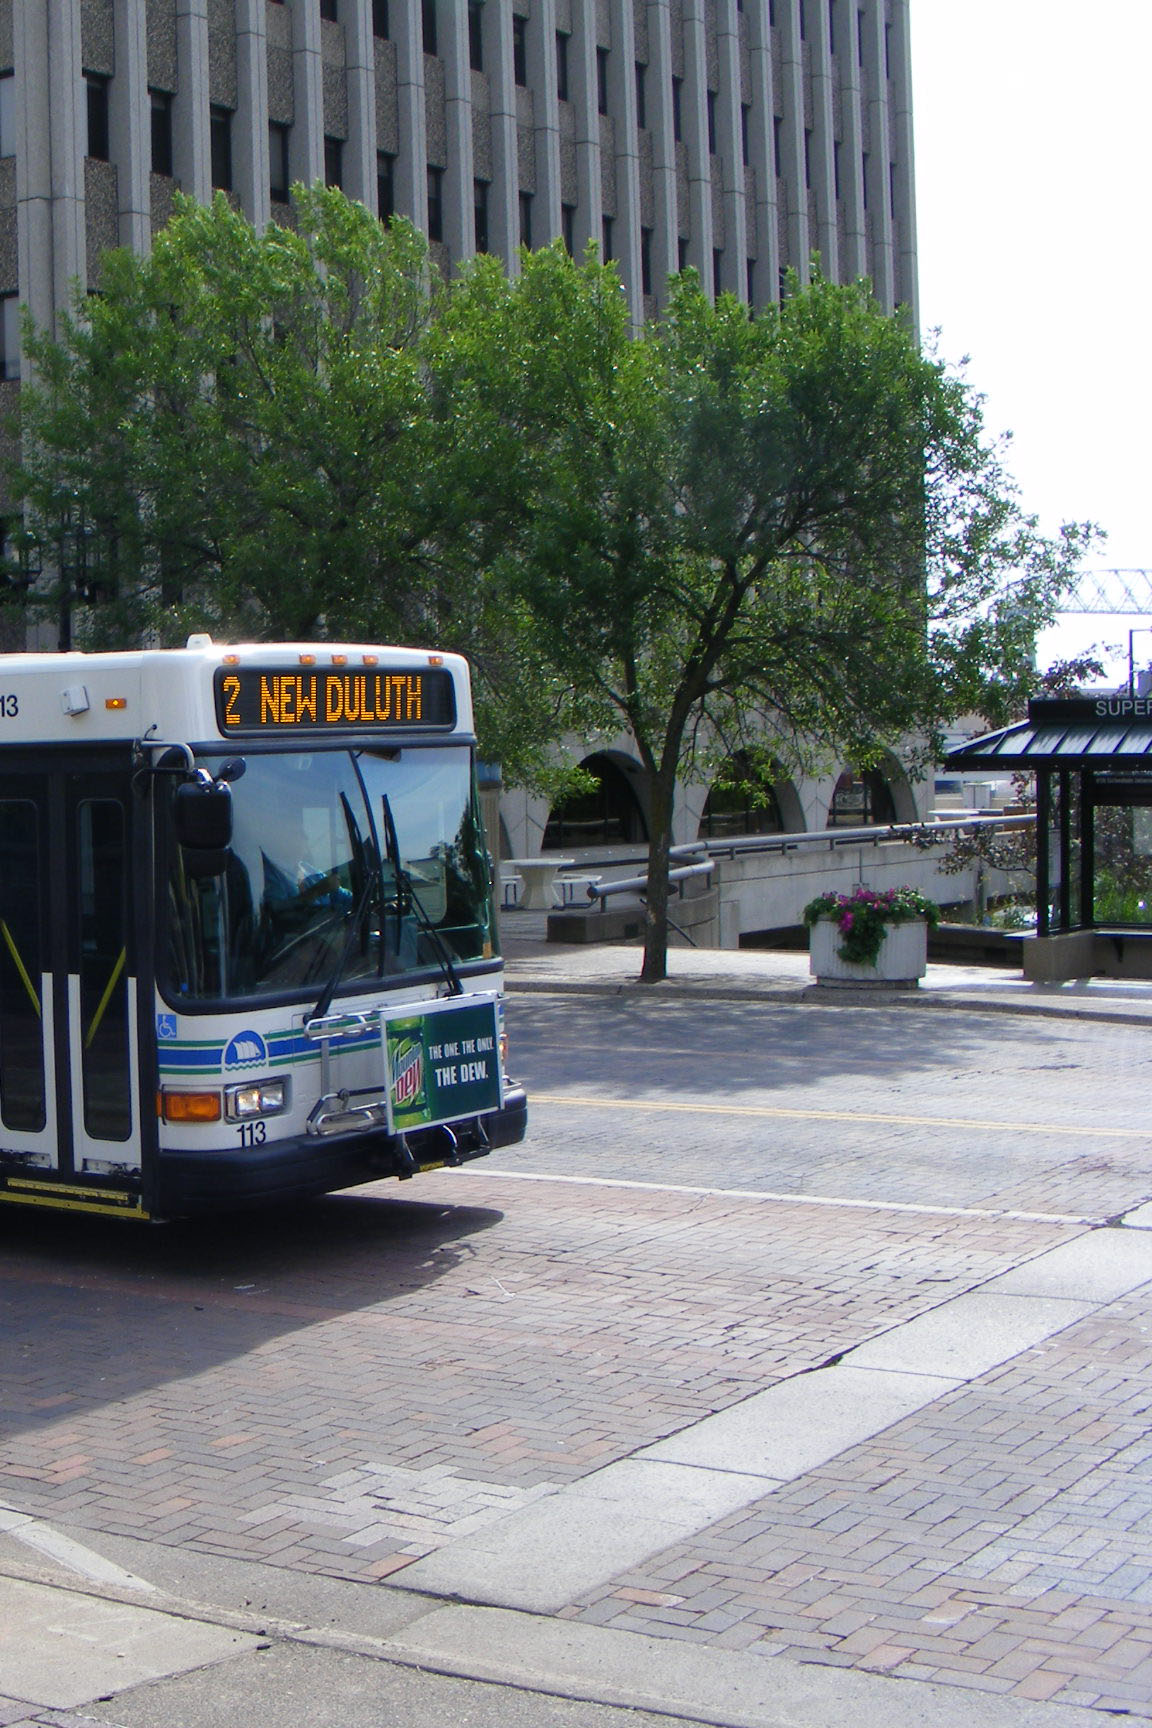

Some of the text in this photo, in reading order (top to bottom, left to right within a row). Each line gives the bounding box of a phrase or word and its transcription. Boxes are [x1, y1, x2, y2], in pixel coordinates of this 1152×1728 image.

[223, 676, 422, 724] 2 NEW DULUTH
[428, 1045, 443, 1060] THE
[462, 1039, 475, 1054] THE
[435, 1060, 488, 1087] THE DEW.
[237, 1121, 266, 1147] 113
